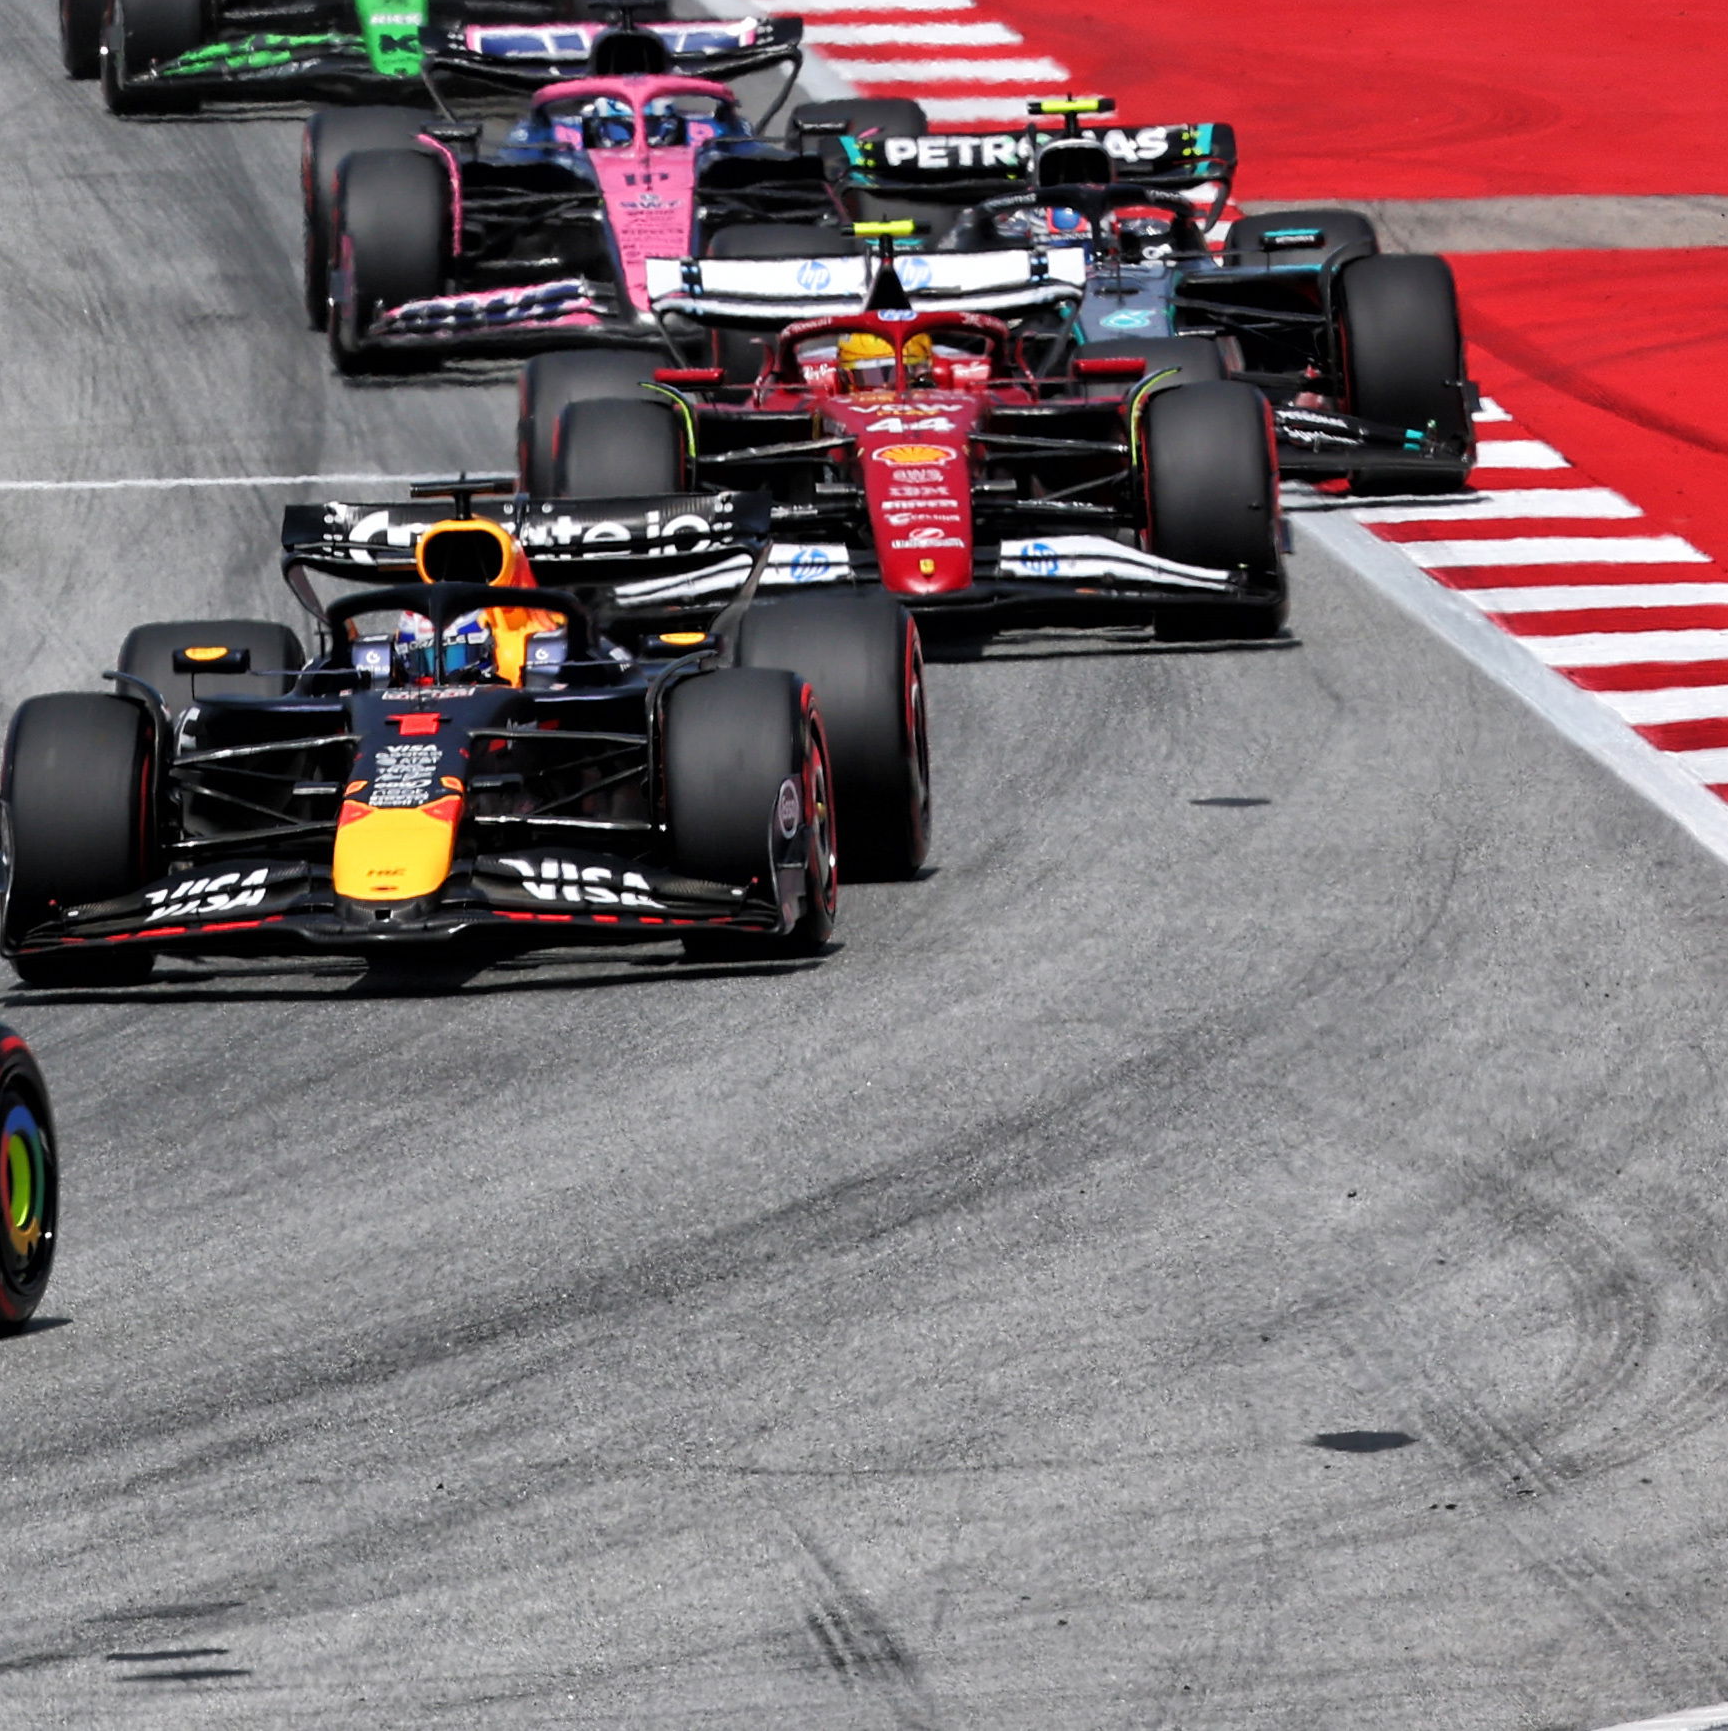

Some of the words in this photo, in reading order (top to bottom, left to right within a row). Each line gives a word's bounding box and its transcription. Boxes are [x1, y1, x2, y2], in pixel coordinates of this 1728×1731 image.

[884, 129, 1169, 169] PETRAS
[796, 260, 831, 291] hp
[865, 417, 956, 433] 44
[789, 547, 830, 582] hp
[408, 633, 467, 651] ORALE
[385, 744, 438, 753] VISA
[145, 867, 269, 922] VISA
[499, 857, 668, 909] VISA
